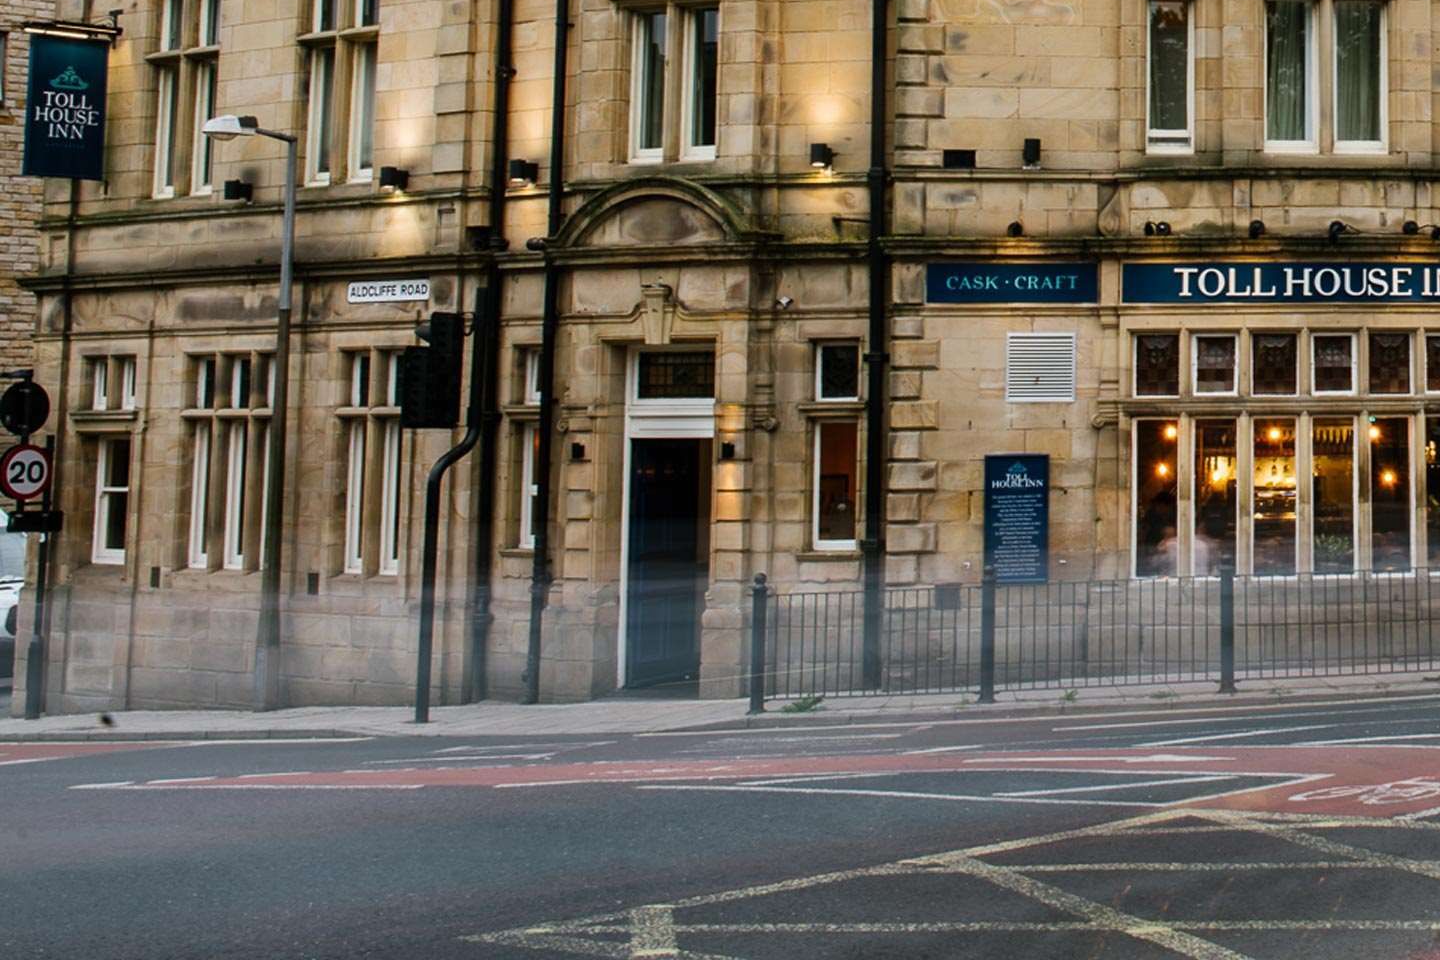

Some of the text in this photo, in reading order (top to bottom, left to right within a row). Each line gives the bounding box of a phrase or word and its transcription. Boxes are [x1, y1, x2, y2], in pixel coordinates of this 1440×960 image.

[43, 91, 93, 110] TOLL
[35, 106, 99, 126] HOUSE
[48, 123, 84, 139] INN
[350, 284, 428, 297] ALDCLIFFE ROAD
[946, 275, 1078, 290] CASK CRAFT
[1173, 267, 1276, 296] TOLL
[1283, 267, 1413, 297] HOUSE
[9, 460, 44, 483] 20
[1025, 480, 1043, 488] INN
